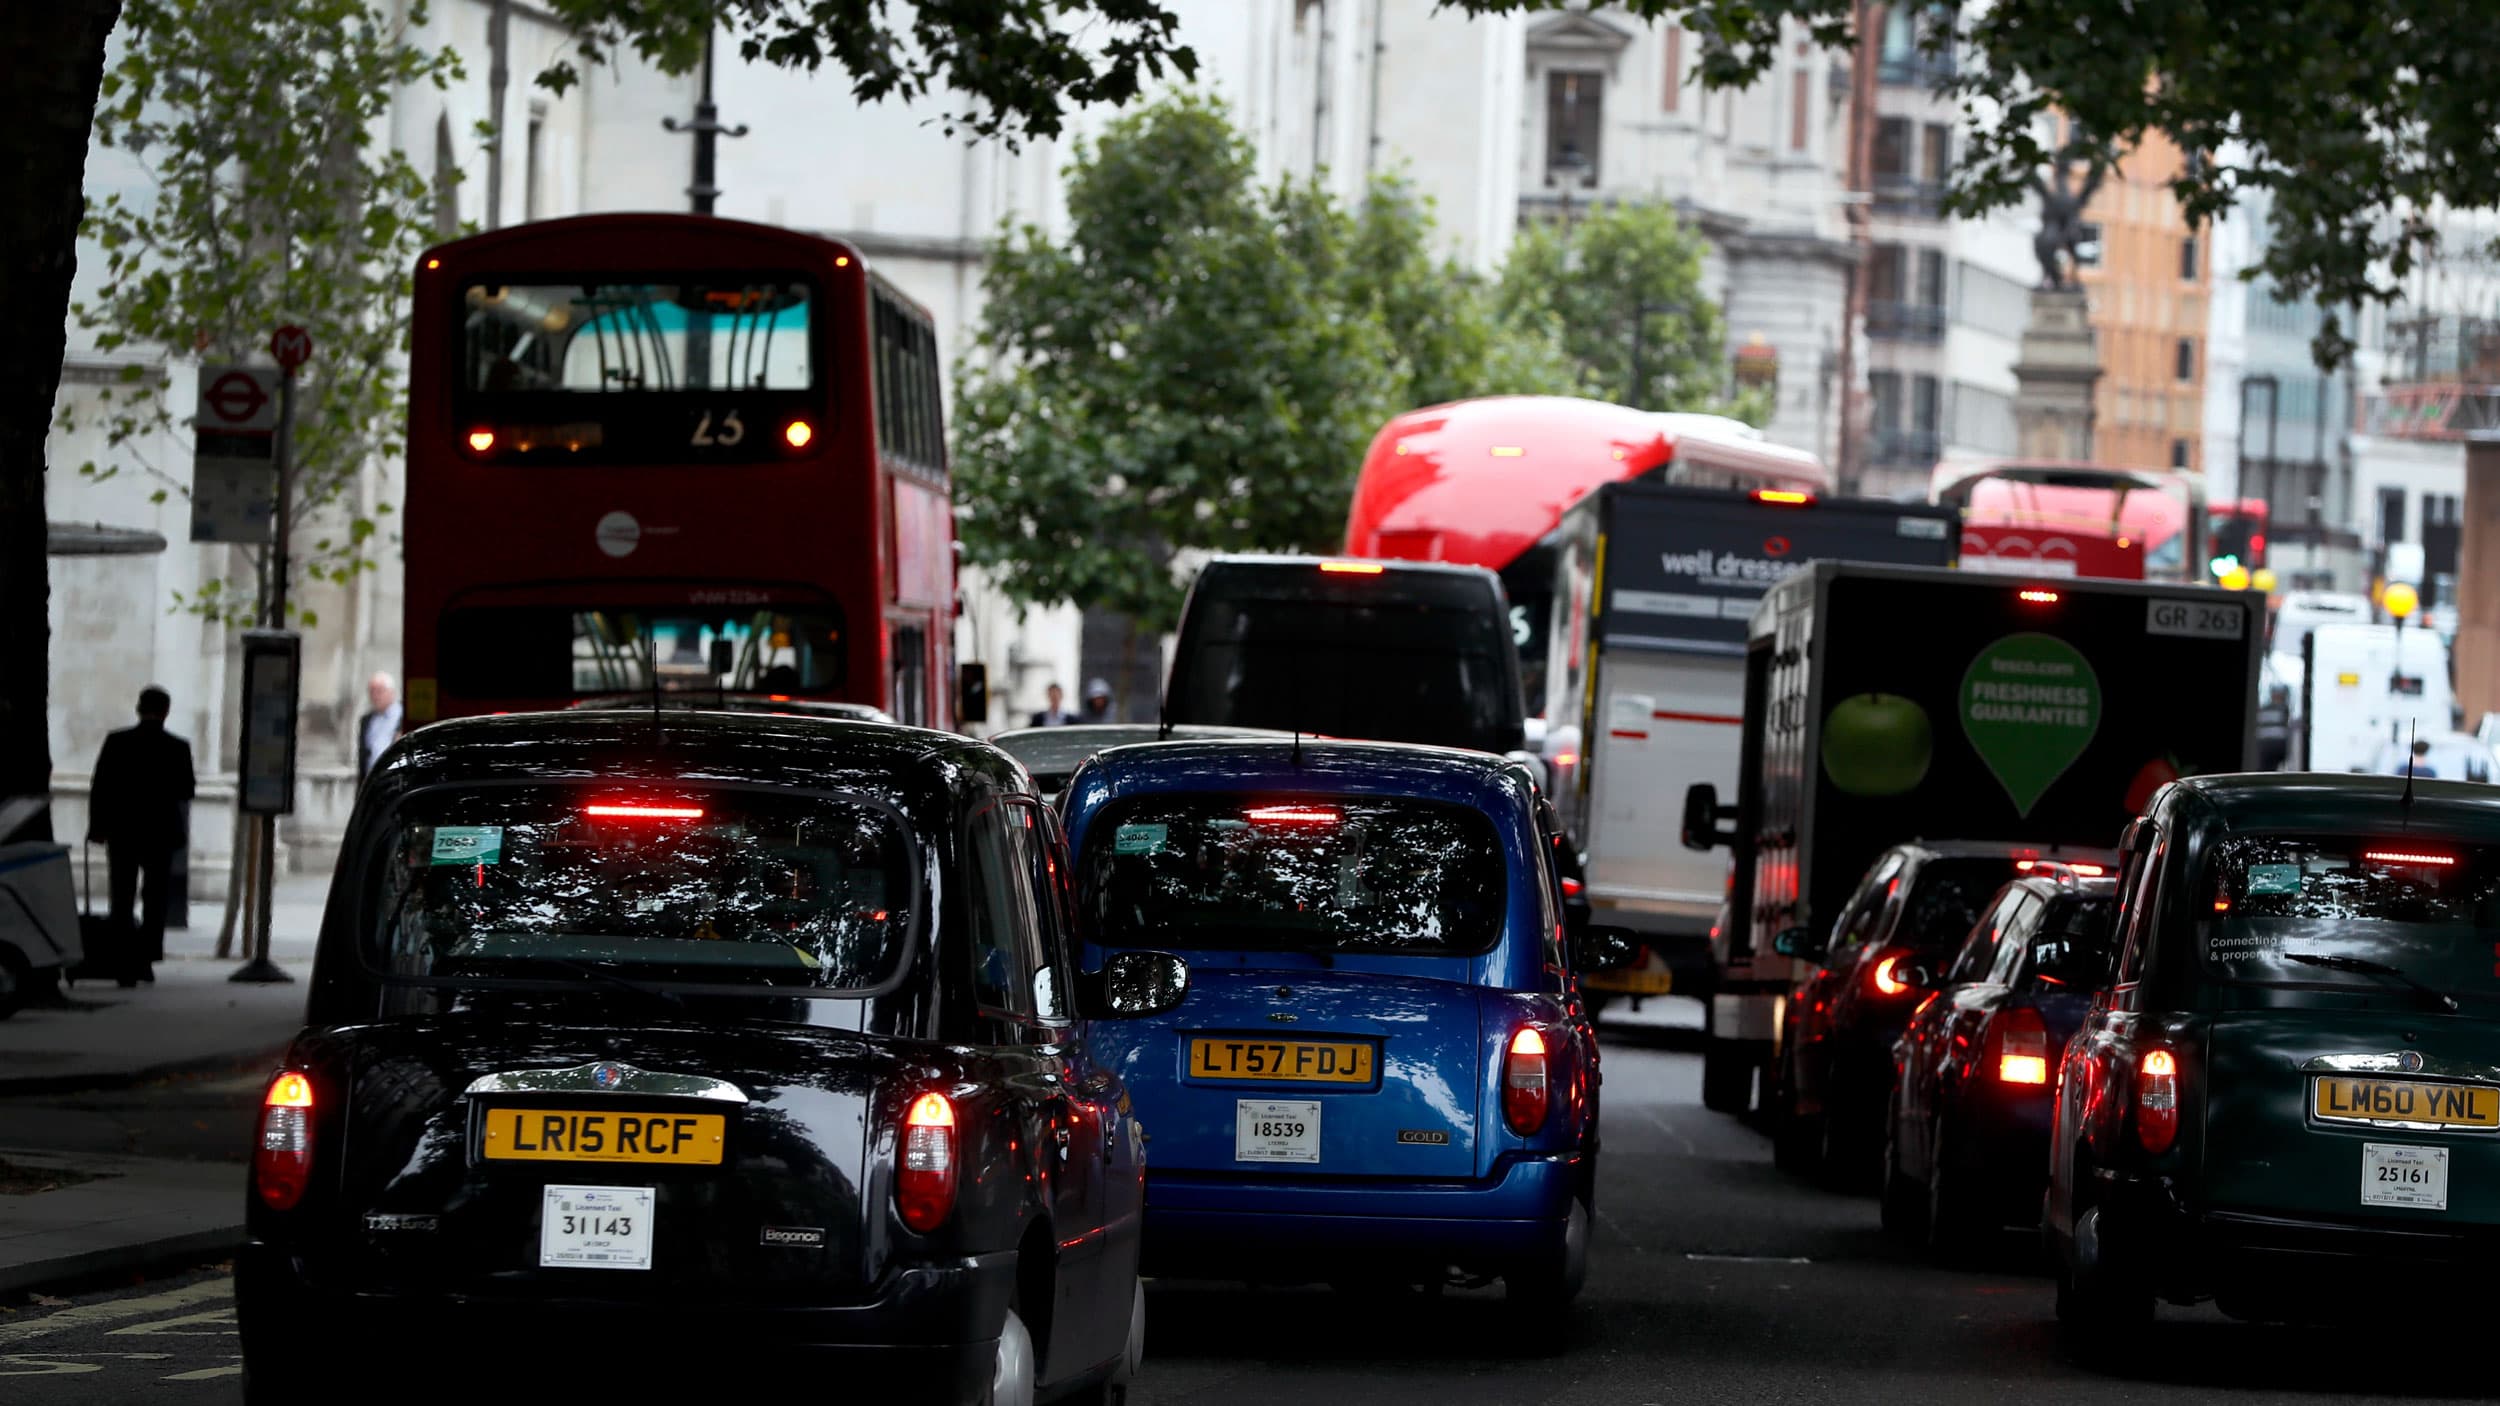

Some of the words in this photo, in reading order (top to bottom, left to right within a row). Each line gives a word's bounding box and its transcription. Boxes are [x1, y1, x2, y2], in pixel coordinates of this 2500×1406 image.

[278, 334, 304, 359] M
[1661, 549, 1714, 576] well
[1715, 550, 1810, 579] dresse
[2155, 606, 2188, 629] GR
[2197, 609, 2240, 632] 263
[1991, 657, 2075, 676] tesco.com
[1972, 681, 2089, 706] FRESHNESS
[1970, 703, 2089, 727] GUARANTEE
[2210, 936, 2277, 948] Connecting
[2210, 951, 2219, 961] &
[1203, 1043, 1286, 1073] LT57
[1296, 1047, 1357, 1076] FDJ
[2329, 1083, 2414, 1115] LM60
[2426, 1088, 2486, 1120] YNL
[513, 1115, 606, 1152] LR15
[617, 1117, 698, 1155] RCF
[1254, 1122, 1305, 1138] 18539
[1403, 1131, 1443, 1142] GOLD
[2378, 1166, 2429, 1185] 25161
[562, 1215, 632, 1236] 31143
